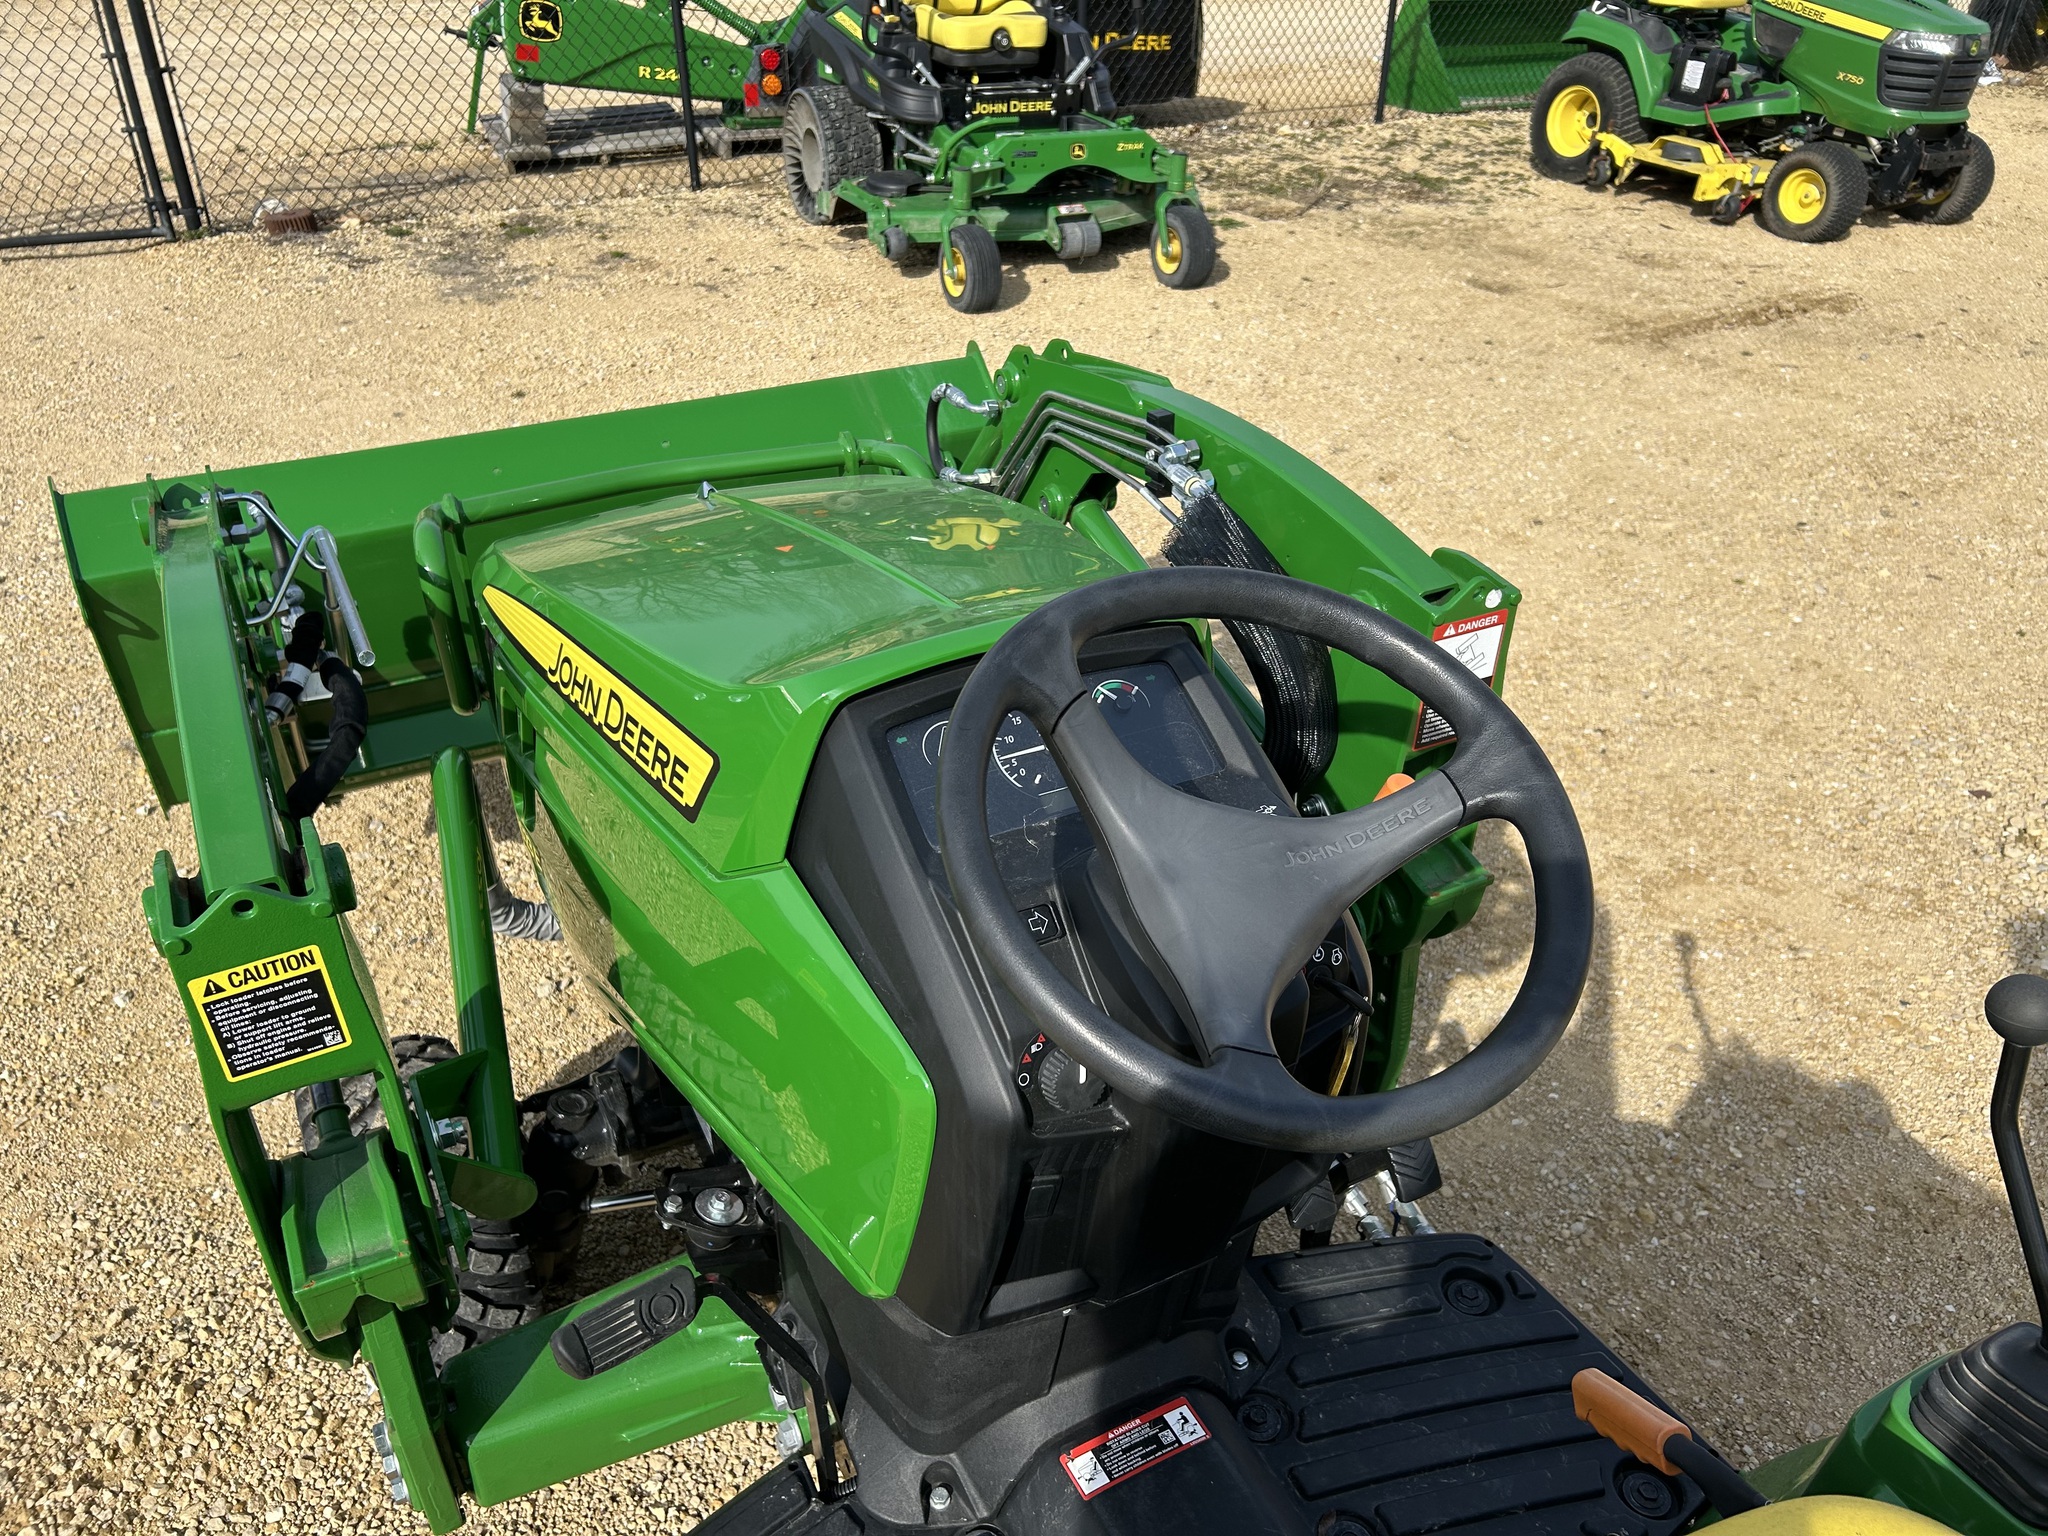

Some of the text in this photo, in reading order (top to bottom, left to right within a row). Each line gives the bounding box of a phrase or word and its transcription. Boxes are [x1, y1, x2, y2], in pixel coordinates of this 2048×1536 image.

[1795, 2, 1826, 21] DEERE
[638, 65, 681, 82] R 24
[1836, 71, 1864, 85] X750
[972, 100, 1053, 115] JOHN DEERE
[1458, 615, 1498, 632] DANGER
[548, 643, 689, 798] JOHN DEERE
[1011, 716, 1022, 726] 15
[1003, 735, 1014, 744] 10
[1011, 758, 1018, 767] 5
[1020, 768, 1026, 776] 0
[1284, 798, 1433, 868] JOHN DEERE
[227, 949, 317, 989] CAUTION
[209, 976, 308, 1009] Lock loader latches before
[212, 1000, 251, 1016] operating.
[215, 987, 312, 1020] Before servicing, adjusting
[217, 1010, 257, 1027] equipment
[267, 992, 318, 1012] disconnecting
[231, 1024, 255, 1035] Lower
[256, 1016, 280, 1027] loader
[289, 1005, 316, 1017] ground
[243, 1025, 272, 1038] support
[284, 1015, 305, 1025] arms.
[236, 1036, 254, 1046] Shut
[292, 1020, 306, 1028] and
[231, 1046, 262, 1060] Observe
[262, 1039, 286, 1051] safety
[237, 1037, 272, 1052] hydraulic
[233, 1055, 252, 1065] tions
[261, 1045, 285, 1057] loader
[1113, 1418, 1142, 1435] DANGER
